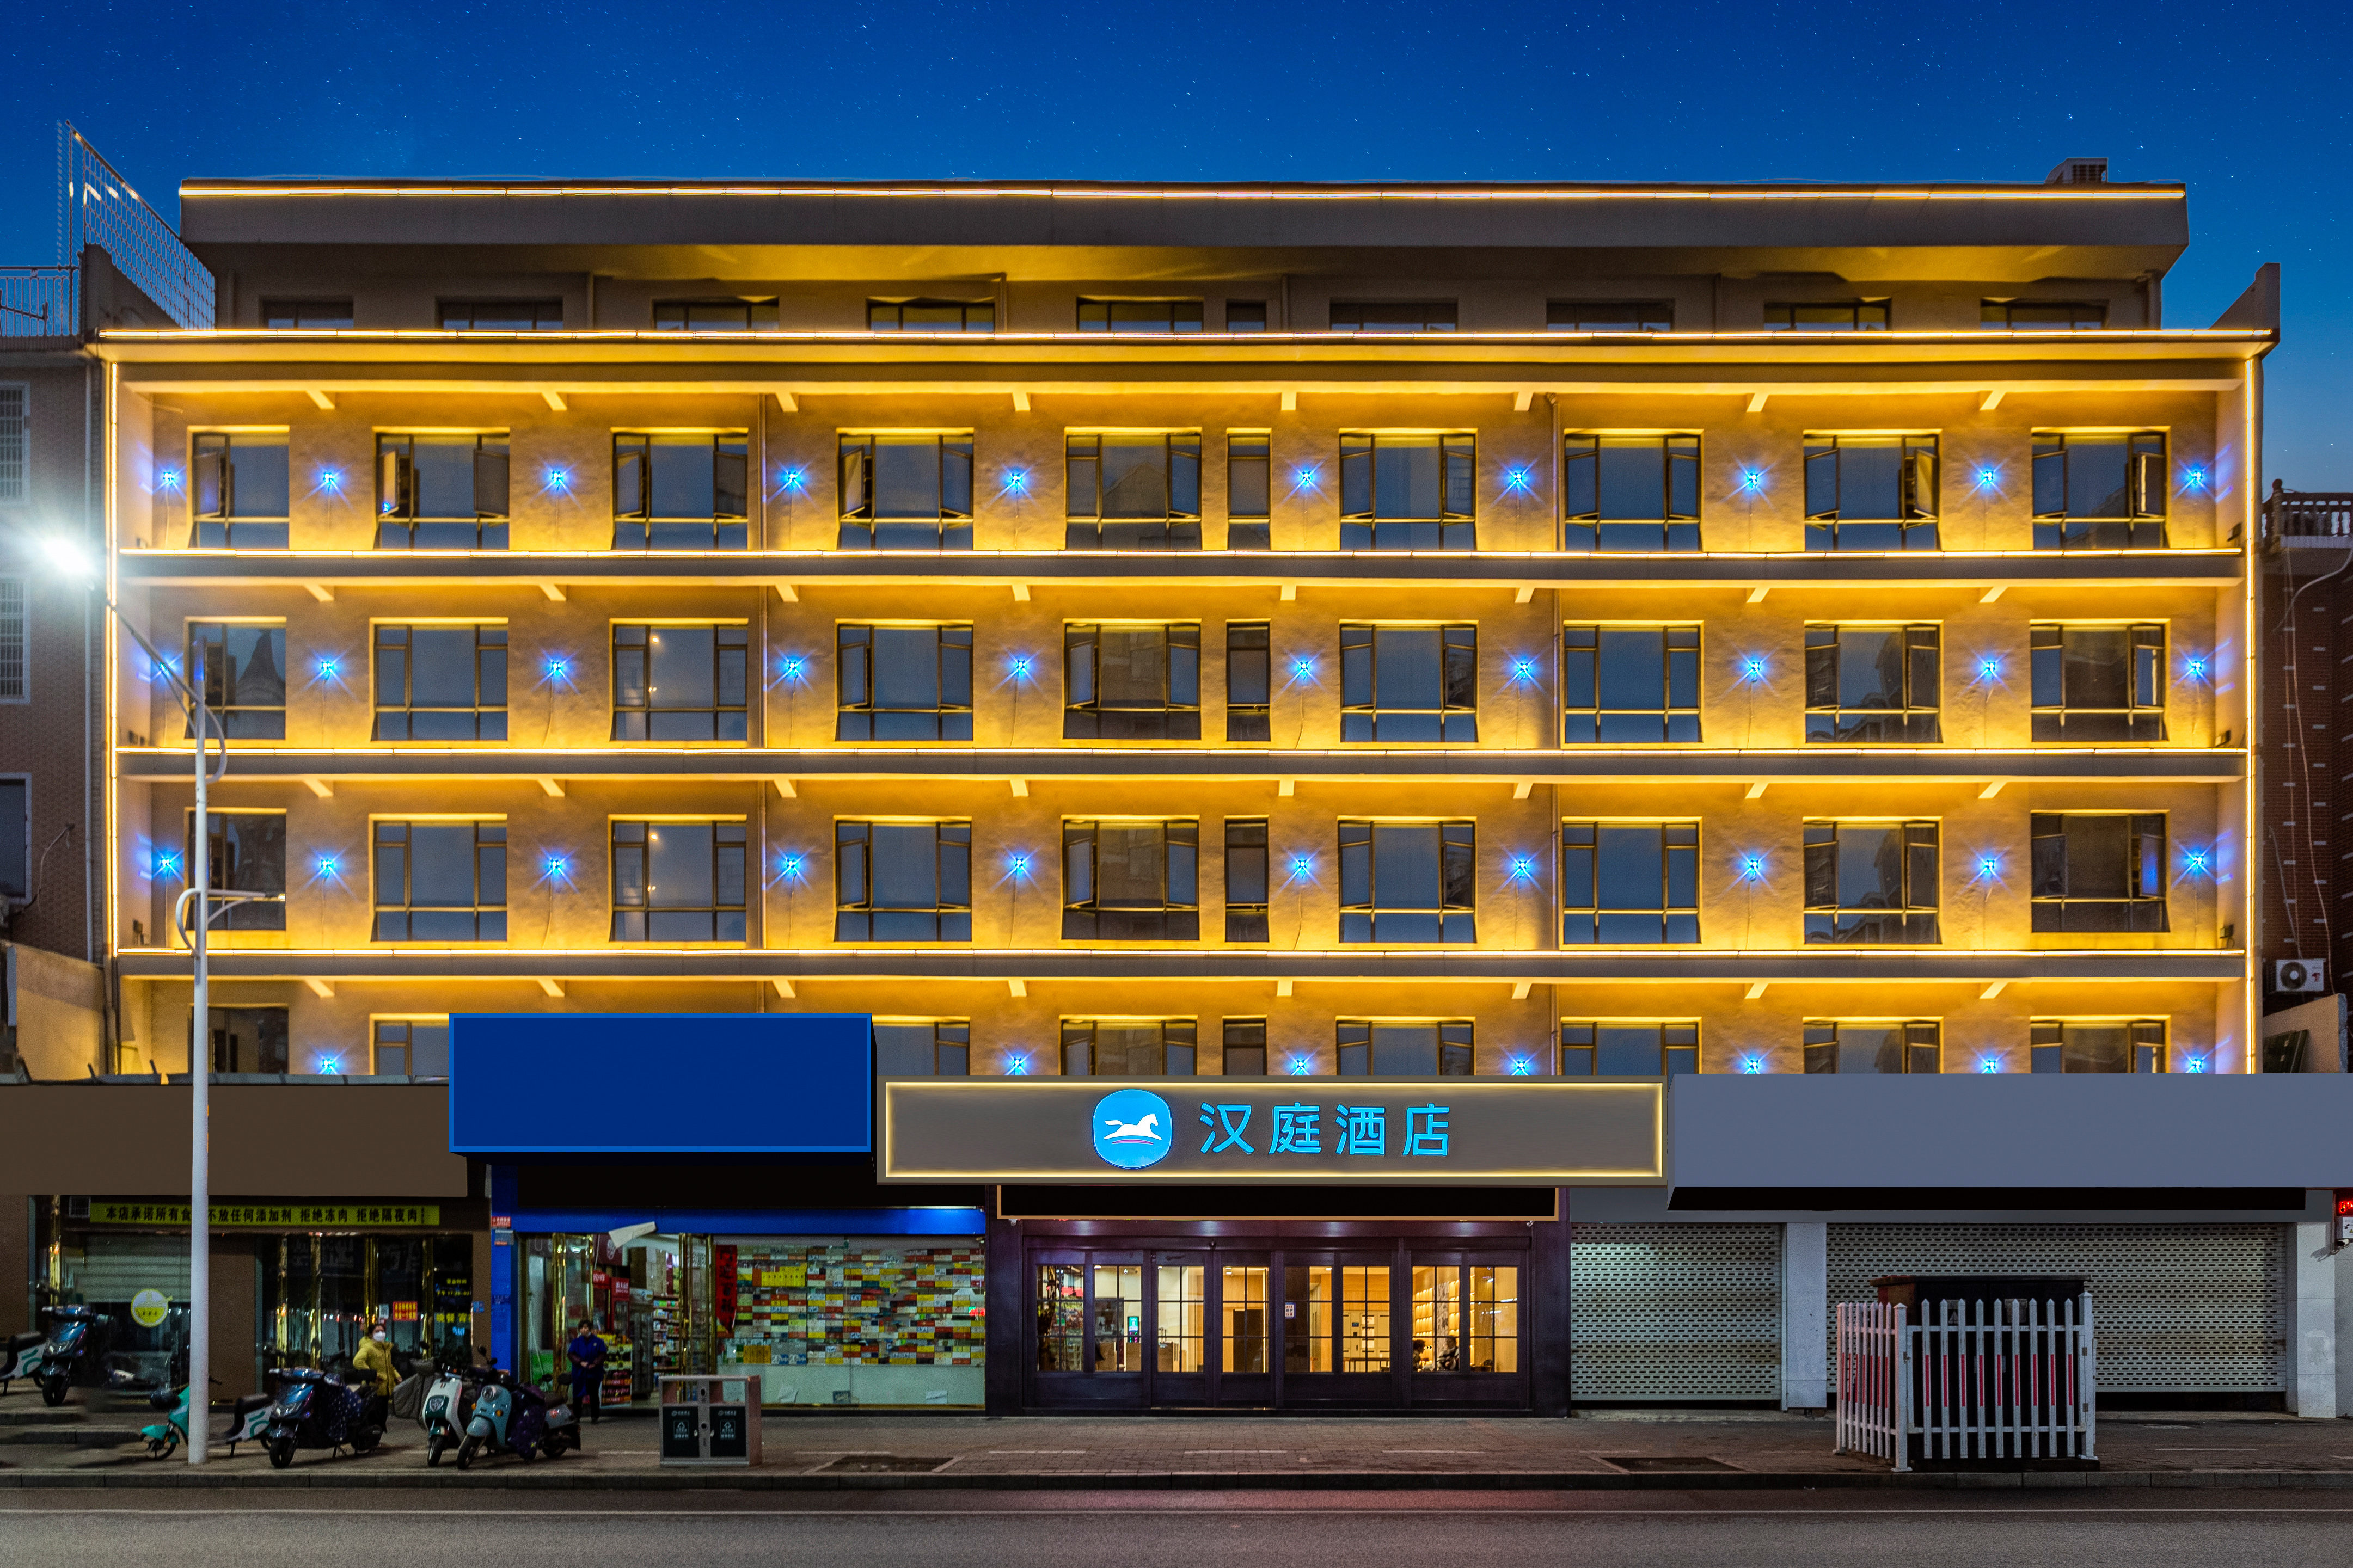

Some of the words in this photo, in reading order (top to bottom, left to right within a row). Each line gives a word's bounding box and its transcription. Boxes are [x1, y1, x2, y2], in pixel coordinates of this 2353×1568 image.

[1199, 1102, 1449, 1156] 汉庭酒店
[107, 1206, 291, 1223] 本店承诺所有食不放任何添加剂
